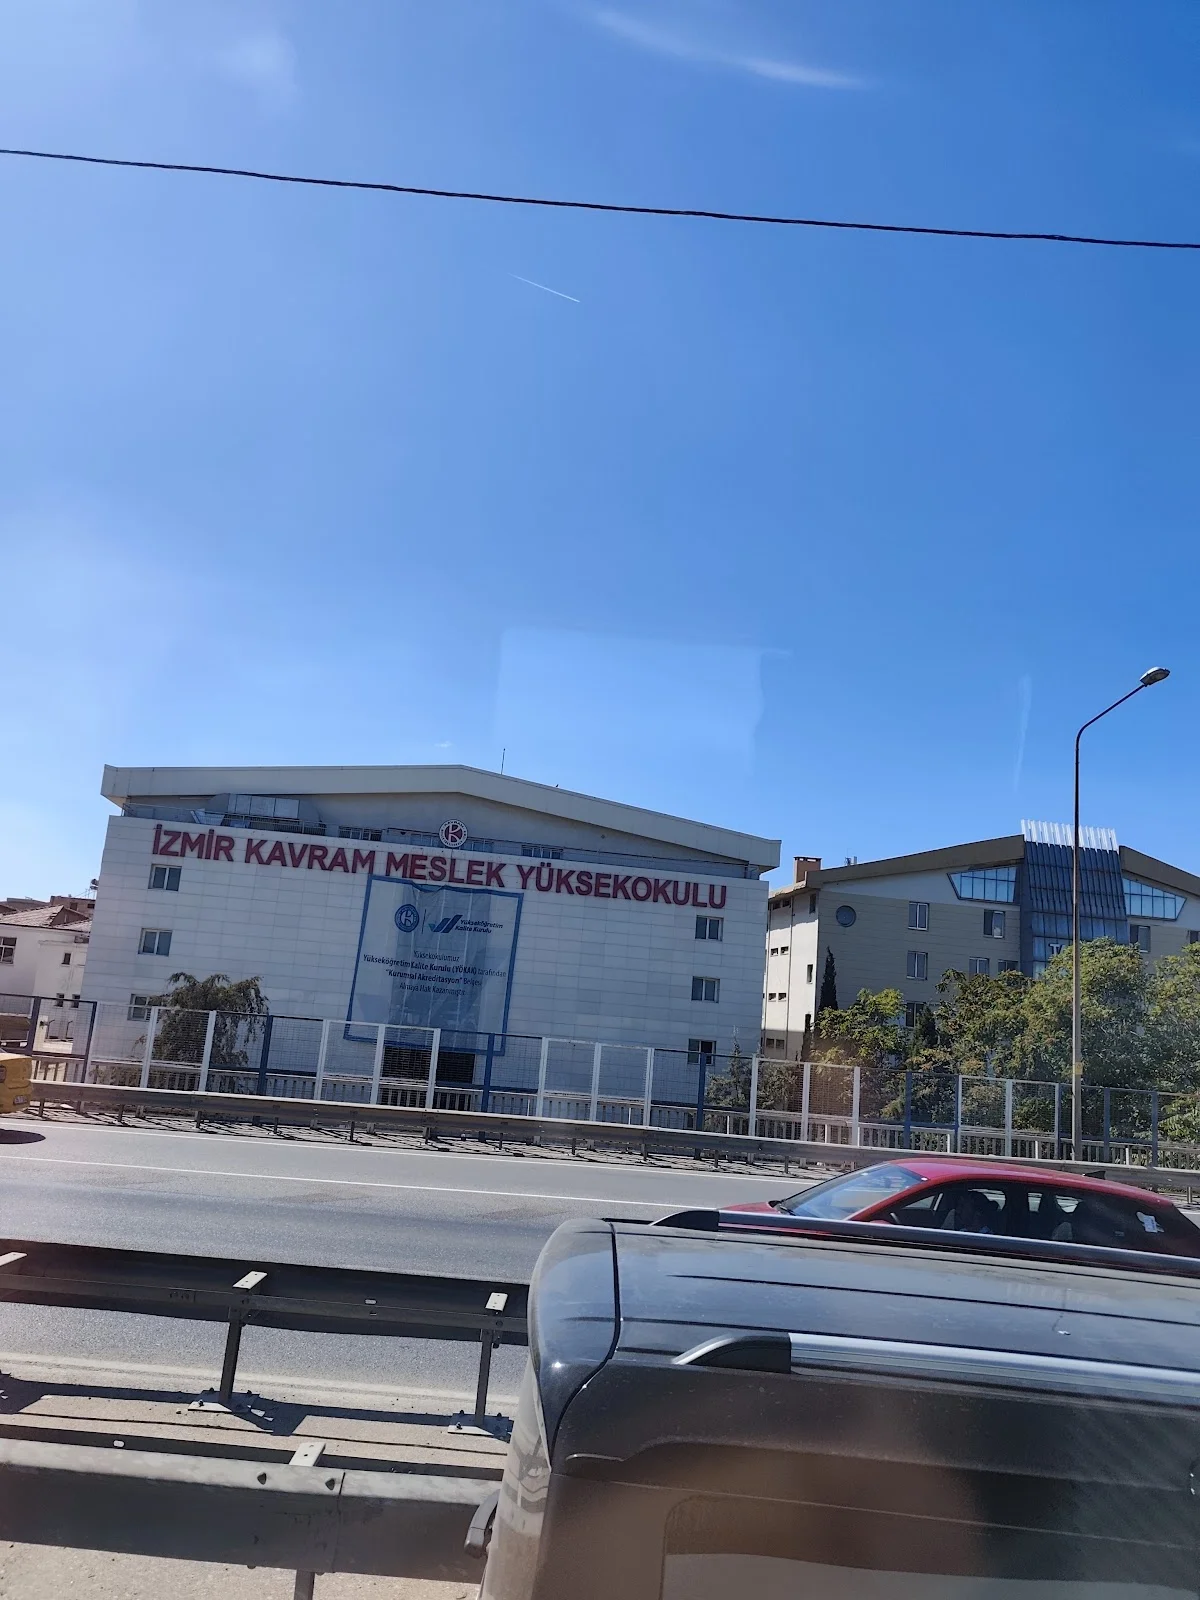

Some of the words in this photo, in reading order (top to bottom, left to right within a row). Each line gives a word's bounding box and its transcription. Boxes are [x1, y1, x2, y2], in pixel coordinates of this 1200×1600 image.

[153, 824, 235, 862] İZMİR
[245, 838, 375, 874] KAVRAM
[385, 852, 506, 887] MESLEK
[517, 862, 727, 909] YÜKSEKOKULU
[363, 954, 410, 967] Yükseköğretim
[411, 962, 429, 970] Kalite
[430, 964, 451, 972] Kurulu
